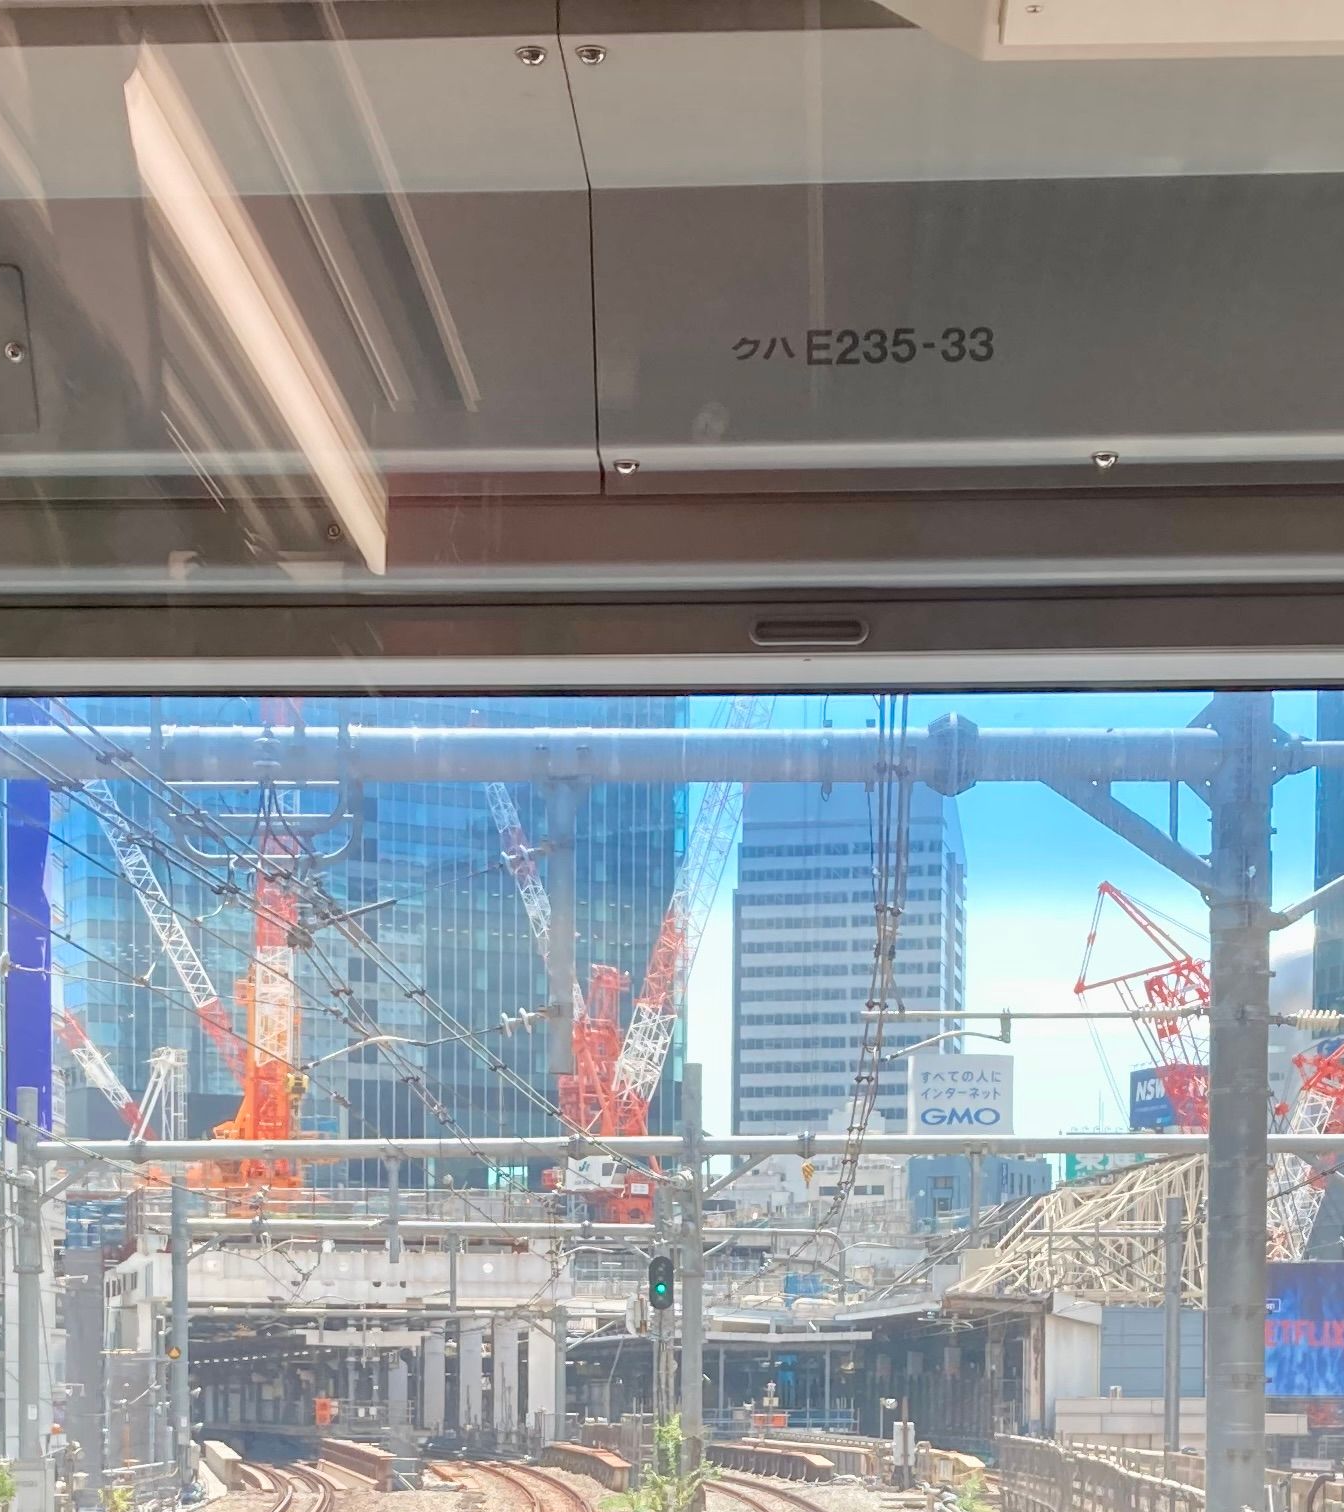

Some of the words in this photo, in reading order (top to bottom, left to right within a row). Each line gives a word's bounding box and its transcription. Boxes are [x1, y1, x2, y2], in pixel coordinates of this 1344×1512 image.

[731, 336, 797, 362] クハ
[805, 325, 996, 366] E235-33
[920, 1069, 1002, 1084] すべての人に
[920, 1086, 1001, 1101] インターネット
[920, 1106, 1001, 1127] GMO
